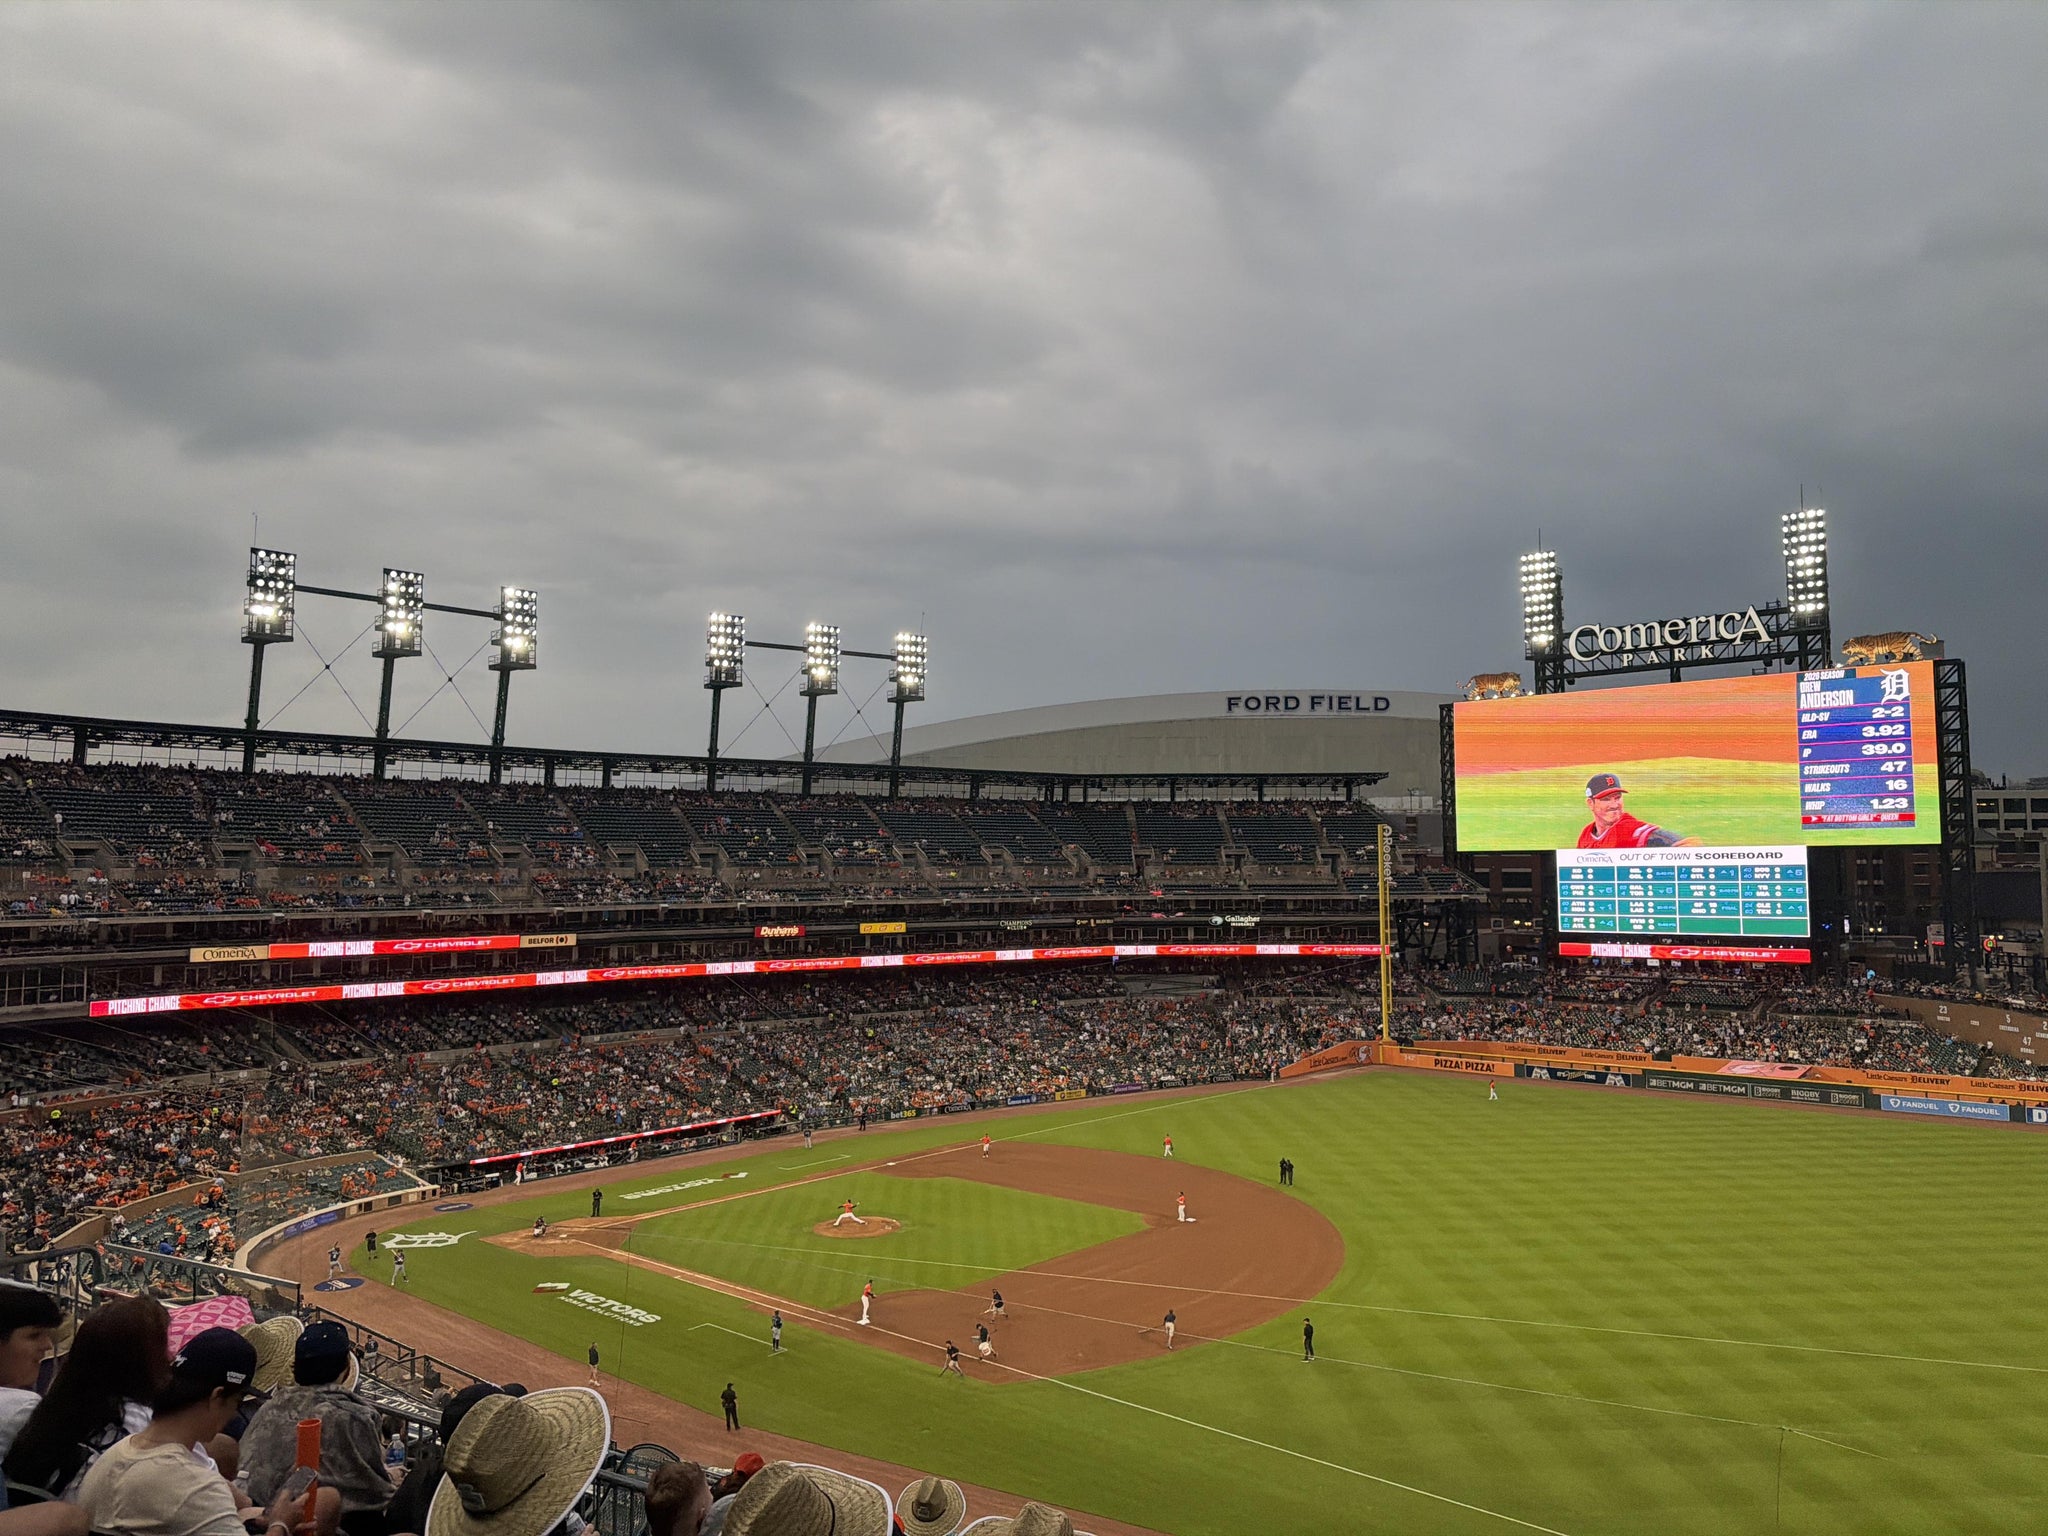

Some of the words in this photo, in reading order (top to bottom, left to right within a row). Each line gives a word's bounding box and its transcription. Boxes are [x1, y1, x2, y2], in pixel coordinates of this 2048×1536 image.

[1622, 644, 1715, 667] PARK
[1820, 670, 1845, 680] SEASON
[1800, 680, 1821, 692] DREW
[1226, 695, 1301, 712] FORD
[1309, 695, 1391, 712] FIELD
[1800, 689, 1854, 709] ANDERSON
[1801, 712, 1830, 722] HLD-SV
[1872, 706, 1905, 718] 2-2
[1802, 730, 1817, 739] ERA
[1862, 724, 1905, 737] 3.92
[1802, 748, 1812, 758] IP
[1861, 743, 1906, 755] 39.0
[1803, 764, 1850, 775] STRIKEOUTS
[1880, 761, 1907, 772] 47
[1804, 783, 1831, 793] WALKS
[1885, 779, 1908, 790] 16
[1805, 801, 1825, 811] WHIP
[1869, 797, 1909, 809] 1.23
[1383, 837, 1393, 881] Rocket
[1620, 853, 1642, 861] OUT
[1659, 852, 1691, 860] TOWN
[1695, 851, 1783, 860] SCOREBOARD
[1225, 915, 1261, 923] Gallagher
[761, 925, 799, 936] Dunham's
[425, 940, 492, 948] CHEVROLET
[528, 937, 554, 945] BELFOR
[309, 942, 344, 957] PITCHING
[345, 941, 374, 955] CHANGE
[1591, 944, 1622, 957] PITCHING
[1624, 944, 1652, 957] CHANGE
[1703, 950, 1779, 958] CHEVROLET
[793, 959, 844, 967] CHEVROLET
[627, 967, 687, 976] CHEVROLET
[453, 978, 516, 987] CHEVROLET
[240, 991, 318, 1001] CHEVROLET
[343, 984, 376, 999] PITCHING
[377, 982, 405, 996] CHANGE
[108, 999, 147, 1015] PITCHING
[148, 996, 180, 1012] CHANGE
[1939, 1005, 1947, 1014] 23
[2006, 1014, 2010, 1023] 5
[2023, 1036, 2031, 1046] 47
[1434, 1058, 1463, 1070] PIZZA!
[1465, 1061, 1495, 1073] PIZZA!
[1866, 1072, 1882, 1081] Little
[1883, 1074, 1907, 1082] Caesars
[1911, 1075, 1950, 1086] DELIVERY
[1656, 1080, 1694, 1090] BETMGM
[1706, 1083, 1746, 1094] BETMGM
[1791, 1089, 1820, 1098] BIGGBY
[890, 1109, 917, 1119] bet365
[1902, 1101, 1939, 1110] FANDUEL
[1961, 1107, 2000, 1116] FANDUEL
[558, 1295, 587, 1308] HOME
[586, 1305, 644, 1327] SOLUTIONS
[568, 1289, 662, 1323] VICTORS
